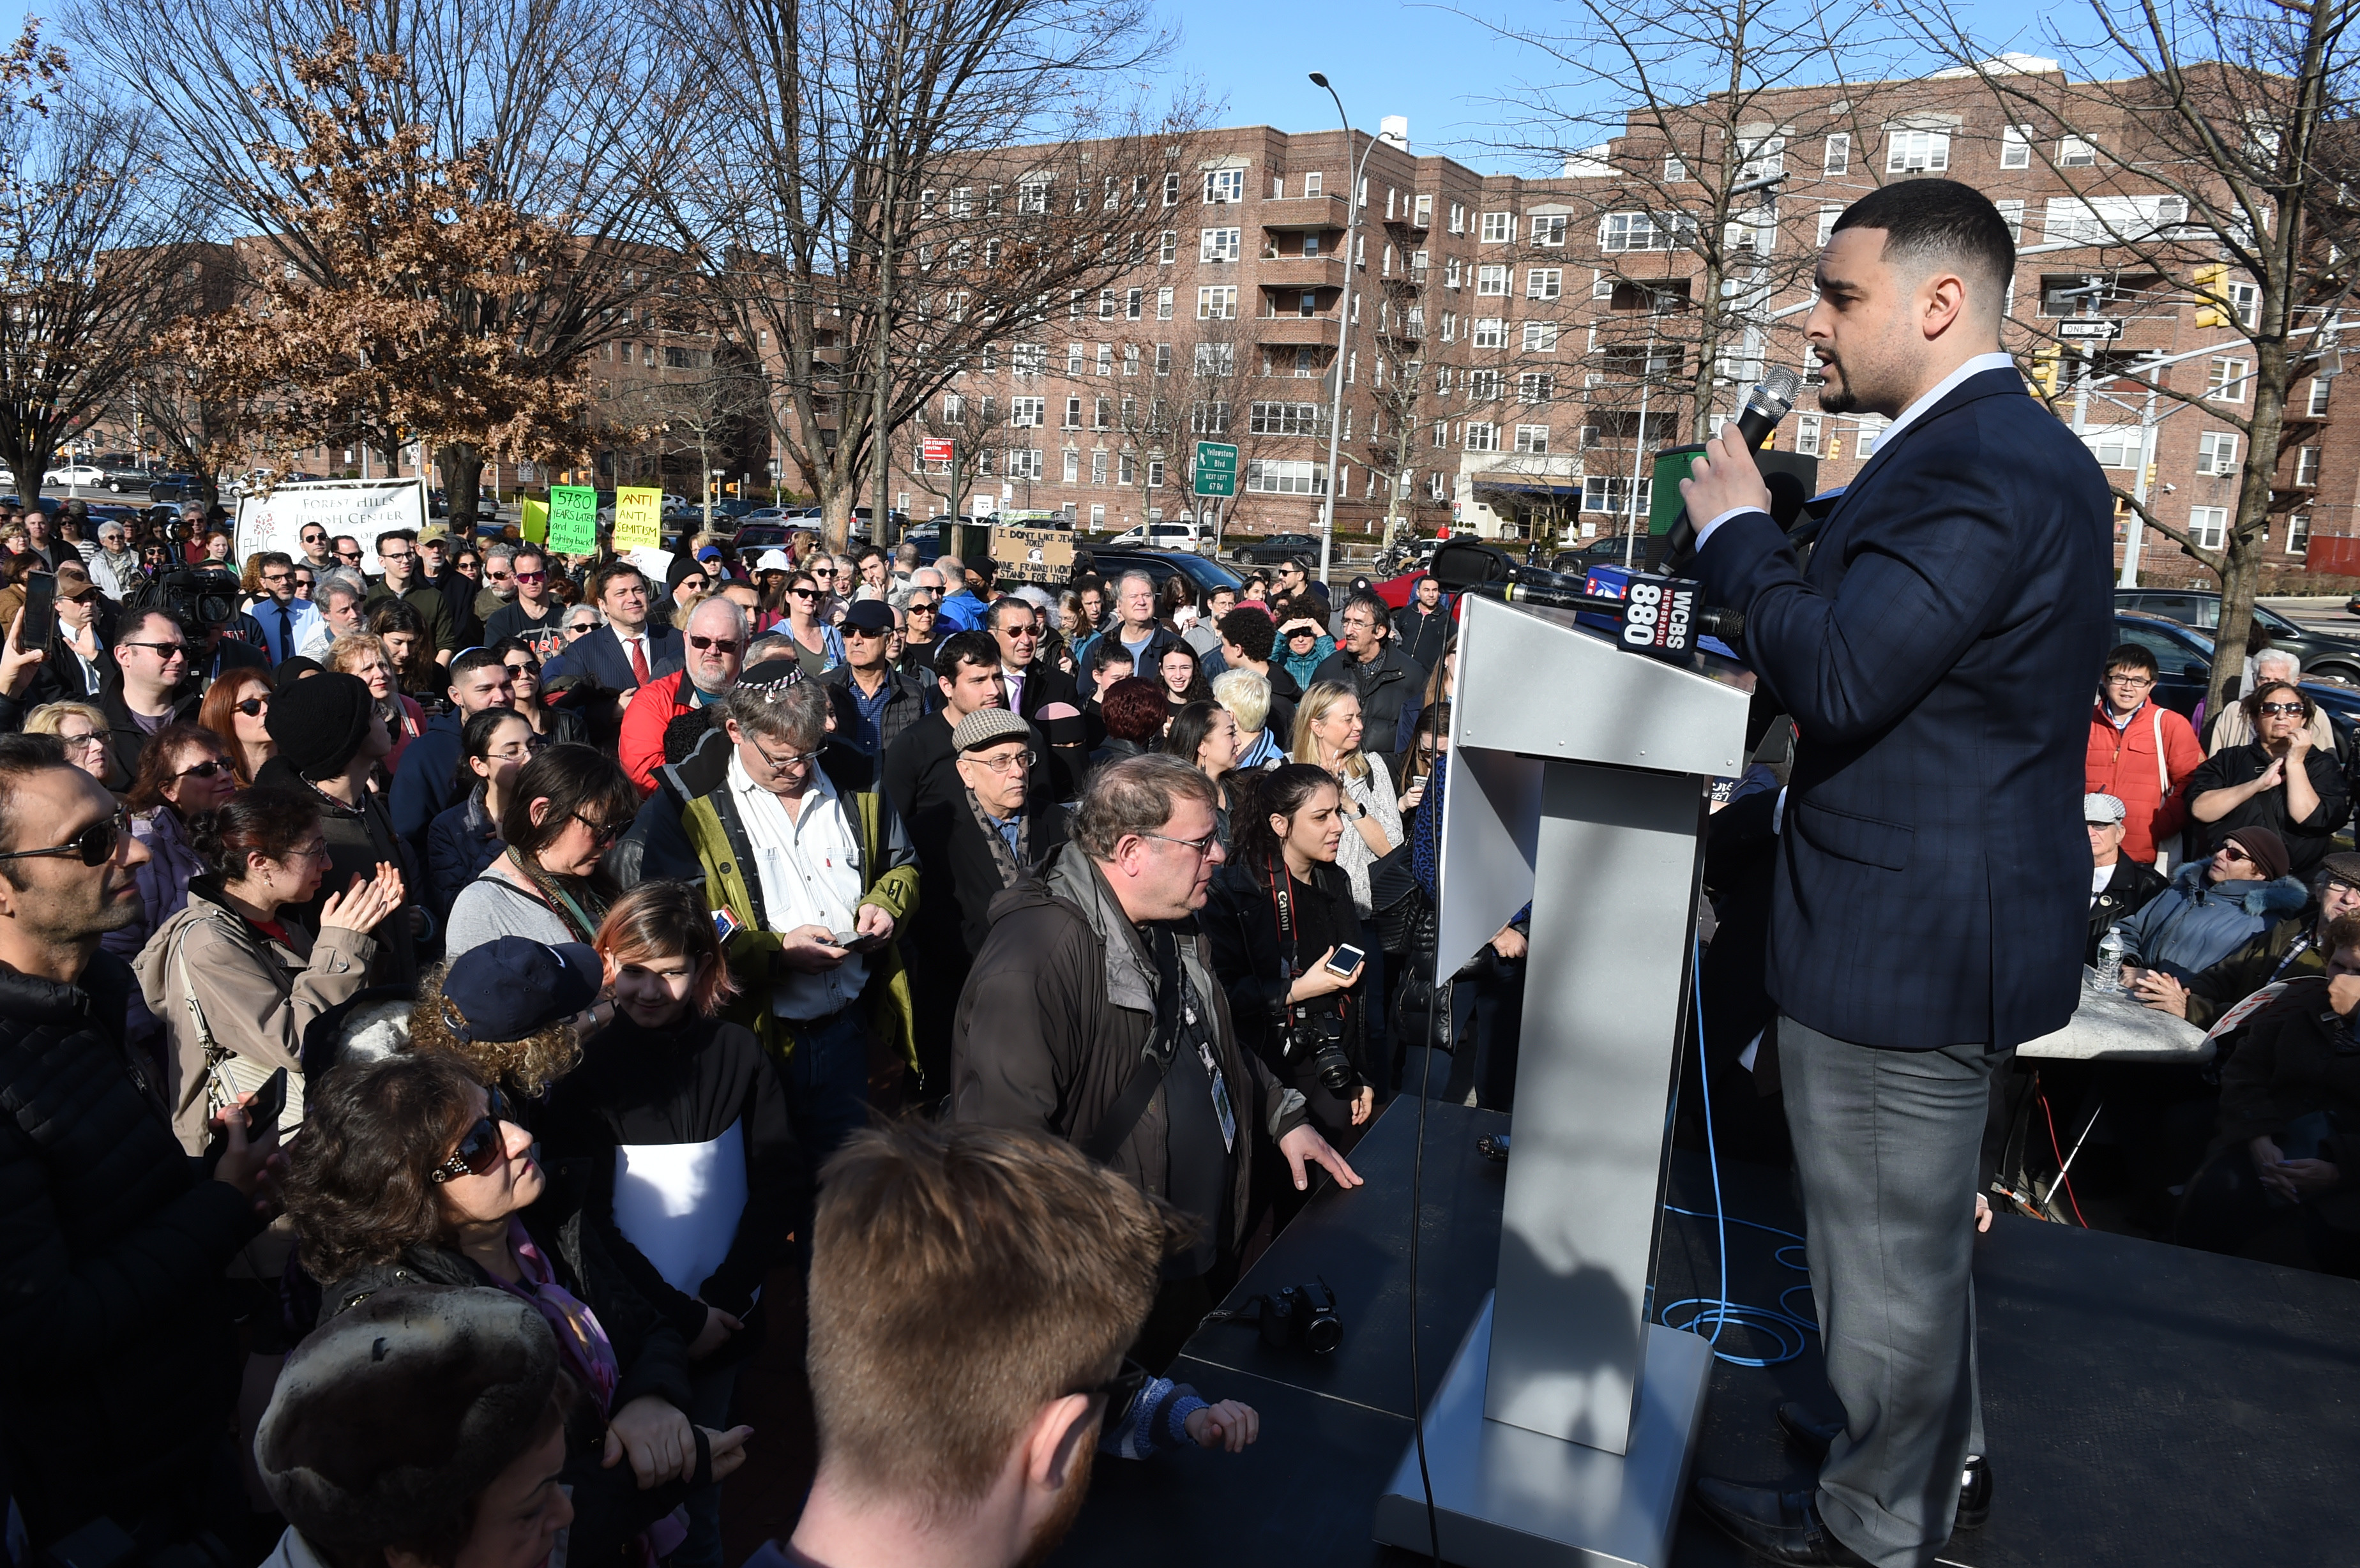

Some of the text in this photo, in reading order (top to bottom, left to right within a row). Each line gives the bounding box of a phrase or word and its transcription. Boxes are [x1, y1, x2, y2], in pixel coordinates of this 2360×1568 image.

[2067, 325, 2085, 333] ONE
[1206, 447, 1234, 458] Yellowstone
[1214, 459, 1225, 468] Blvd
[1209, 482, 1223, 491] 67 Rd
[303, 495, 395, 509] FOREST HILLS
[557, 492, 592, 509] 5780
[622, 494, 653, 507] ANTI
[295, 511, 404, 526] JEWISH CENTER
[552, 508, 595, 523] YEARS LATER
[619, 509, 653, 522] ANTI-
[552, 522, 567, 531] and
[616, 522, 657, 538] SEMITISM
[552, 532, 574, 548] fighting
[997, 528, 1074, 543] I DONT LIKE JEW
[1024, 539, 1045, 548] JOKES
[999, 569, 1071, 584] STAND FOR THEM
[1050, 564, 1053, 573] I
[1054, 564, 1071, 575] WONT
[1624, 583, 1661, 646] 880
[1655, 589, 1672, 645] NEWSRADIO
[1666, 591, 1693, 650] WCBS
[1278, 891, 1290, 931] Canon
